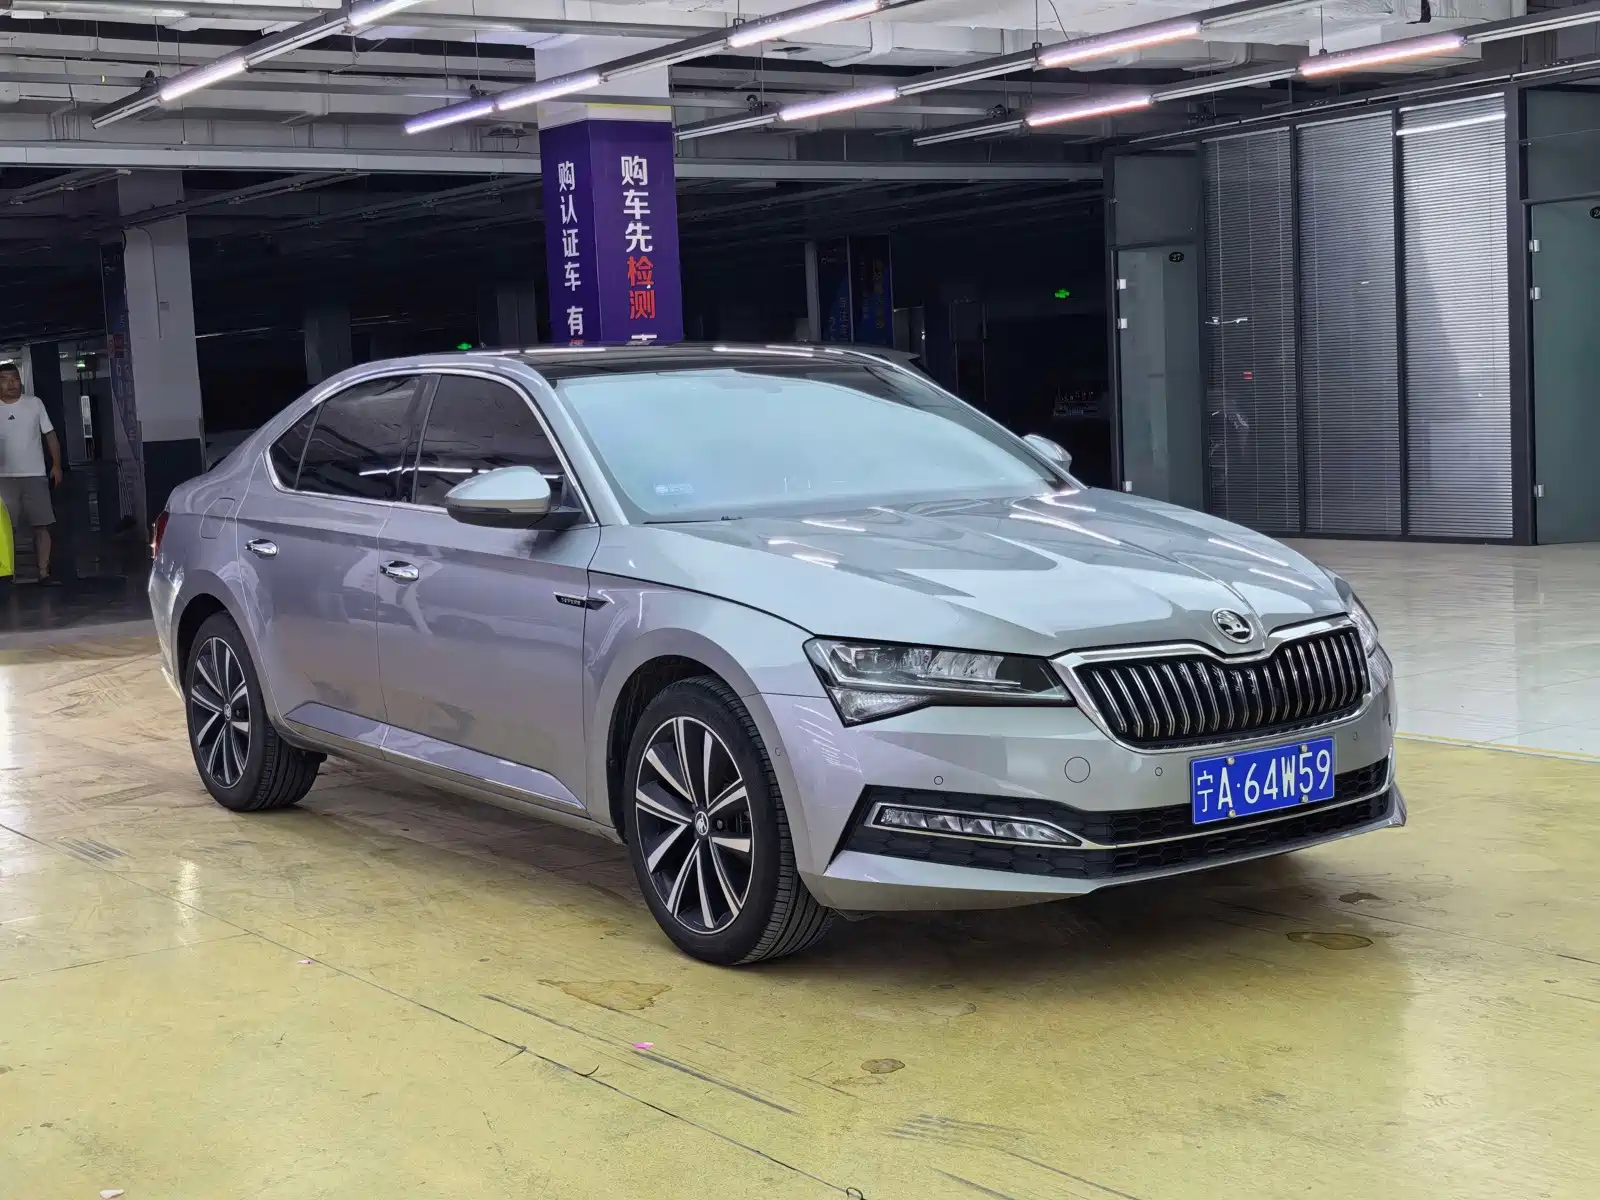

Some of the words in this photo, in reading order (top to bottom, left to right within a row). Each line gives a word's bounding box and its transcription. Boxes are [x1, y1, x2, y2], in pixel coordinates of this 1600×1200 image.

[557, 160, 582, 292] 购认证车
[620, 155, 656, 320] 购车先检测
[566, 305, 585, 345] 有
